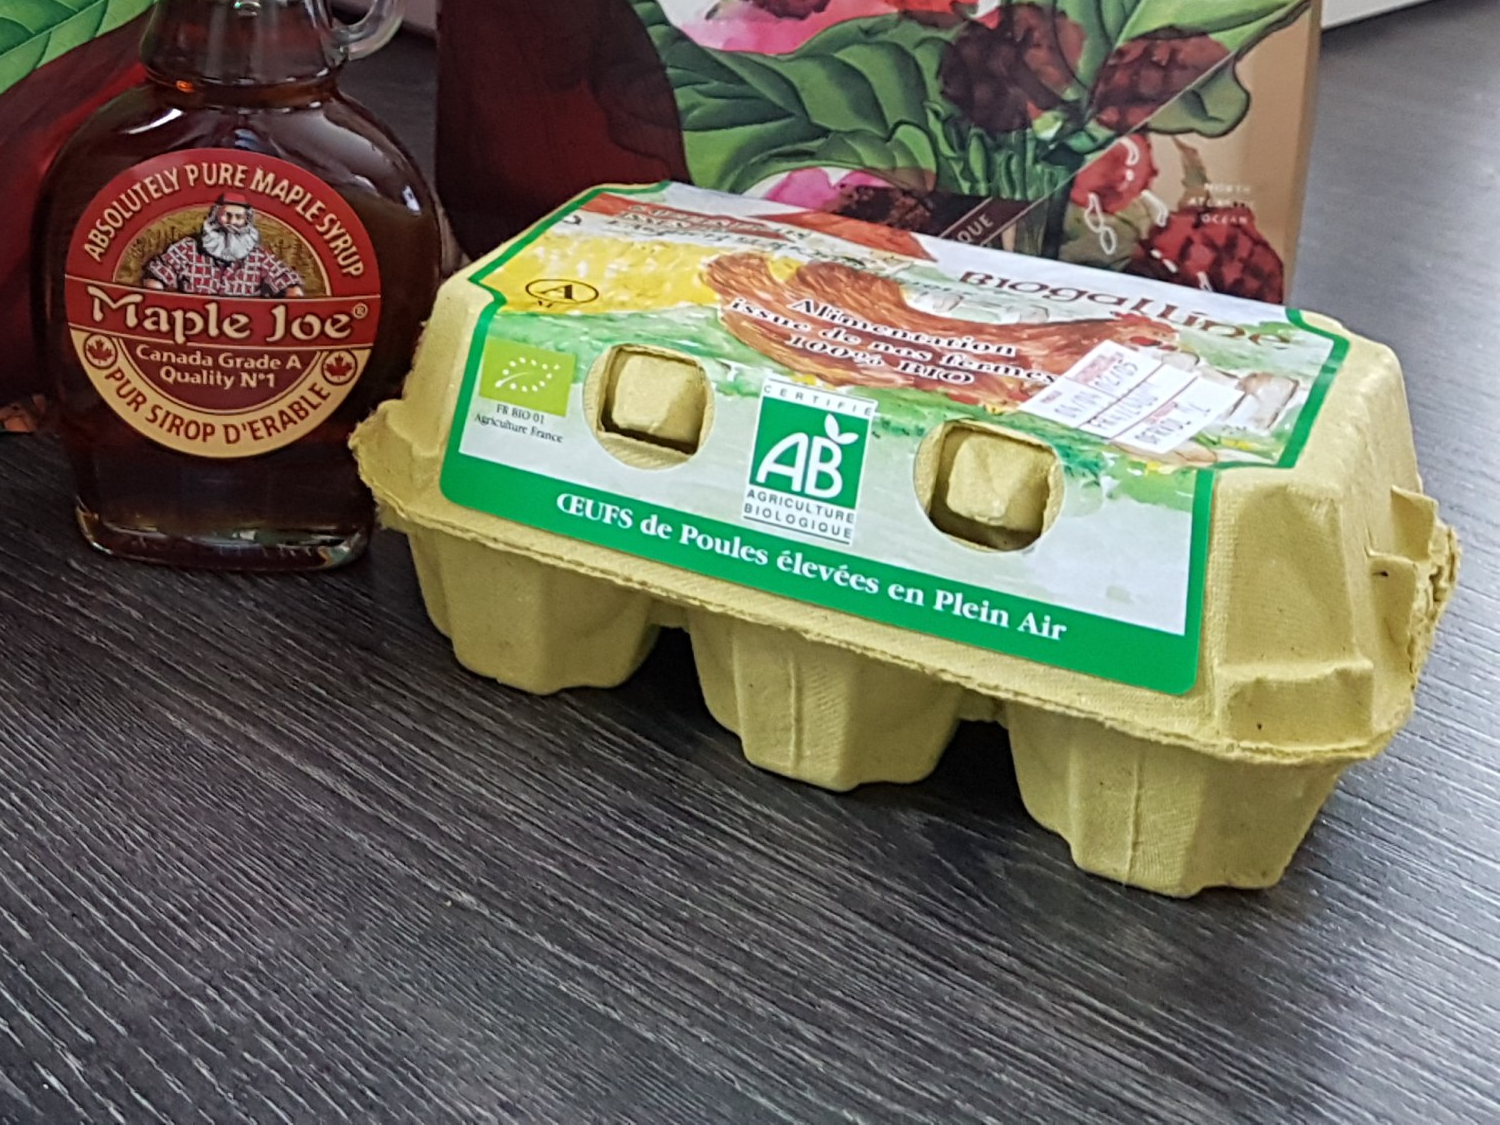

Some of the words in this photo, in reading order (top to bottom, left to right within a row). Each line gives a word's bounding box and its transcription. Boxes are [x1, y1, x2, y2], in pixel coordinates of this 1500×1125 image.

[84, 167, 182, 262] ABSOLUTELY
[185, 162, 248, 189] PURE
[252, 167, 327, 225] MAPLE
[313, 213, 365, 278] SYRUP
[1201, 214, 1248, 224] OCEAN
[87, 285, 252, 344] Maple
[266, 303, 351, 343] Joe
[730, 297, 813, 335] issue
[822, 321, 862, 346] de
[871, 338, 933, 363] nos
[940, 350, 1058, 383] fermes
[788, 299, 1017, 357] Alimentation
[135, 344, 213, 367] Canada
[219, 352, 281, 370] Grade
[285, 355, 302, 369] A
[160, 366, 235, 391] Quality
[787, 336, 885, 369] 100%
[897, 361, 976, 387] BIO
[105, 367, 147, 413] PUR
[145, 404, 216, 444] SIROP
[223, 382, 331, 445] D'ERABLE
[473, 412, 528, 435] Agriculture
[530, 425, 564, 443] France
[496, 403, 509, 415] FR
[511, 406, 532, 421] BIO
[532, 412, 545, 425] 01
[755, 431, 844, 499] AB
[743, 504, 853, 540] BIOLOGIQUE
[746, 488, 855, 524] AGRICULTURE
[639, 512, 673, 539] de
[678, 523, 770, 567] Poules
[776, 551, 880, 595] élevées
[887, 581, 926, 606] en
[932, 588, 1011, 628] Plein
[1015, 609, 1068, 641] Air
